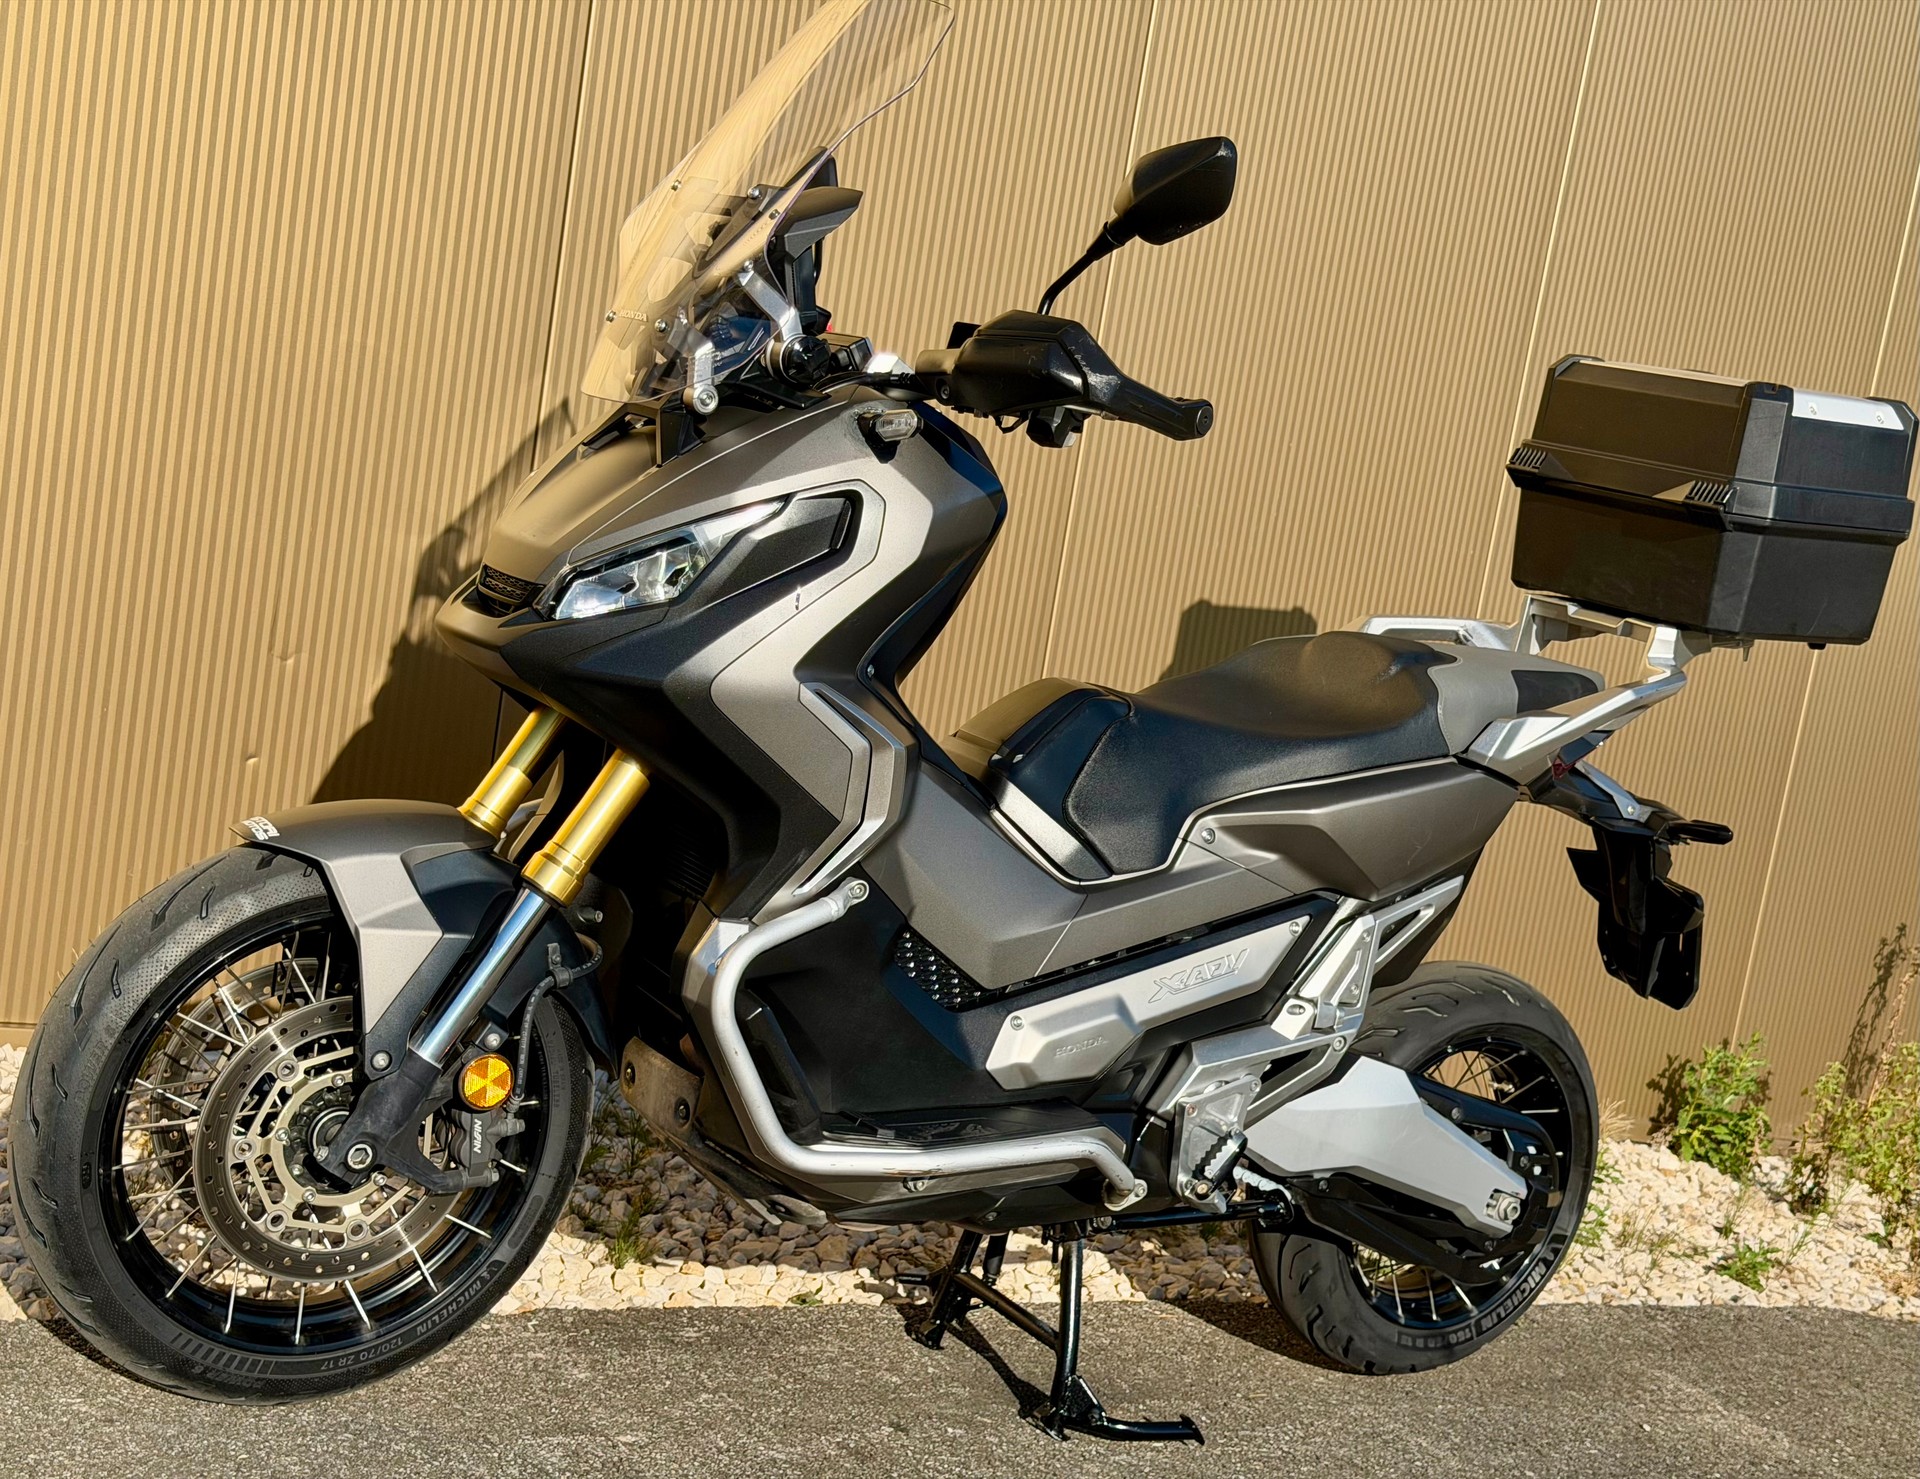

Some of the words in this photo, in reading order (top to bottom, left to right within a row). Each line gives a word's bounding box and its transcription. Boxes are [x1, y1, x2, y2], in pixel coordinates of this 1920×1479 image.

[619, 309, 648, 322] HONDA
[1055, 1036, 1109, 1058] HONDA
[1481, 1260, 1547, 1331] MICHELIN
[416, 1280, 481, 1336] MICHELIN
[360, 1337, 403, 1361] 120/70
[321, 1360, 334, 1370] 17
[338, 1355, 355, 1366] ZR
